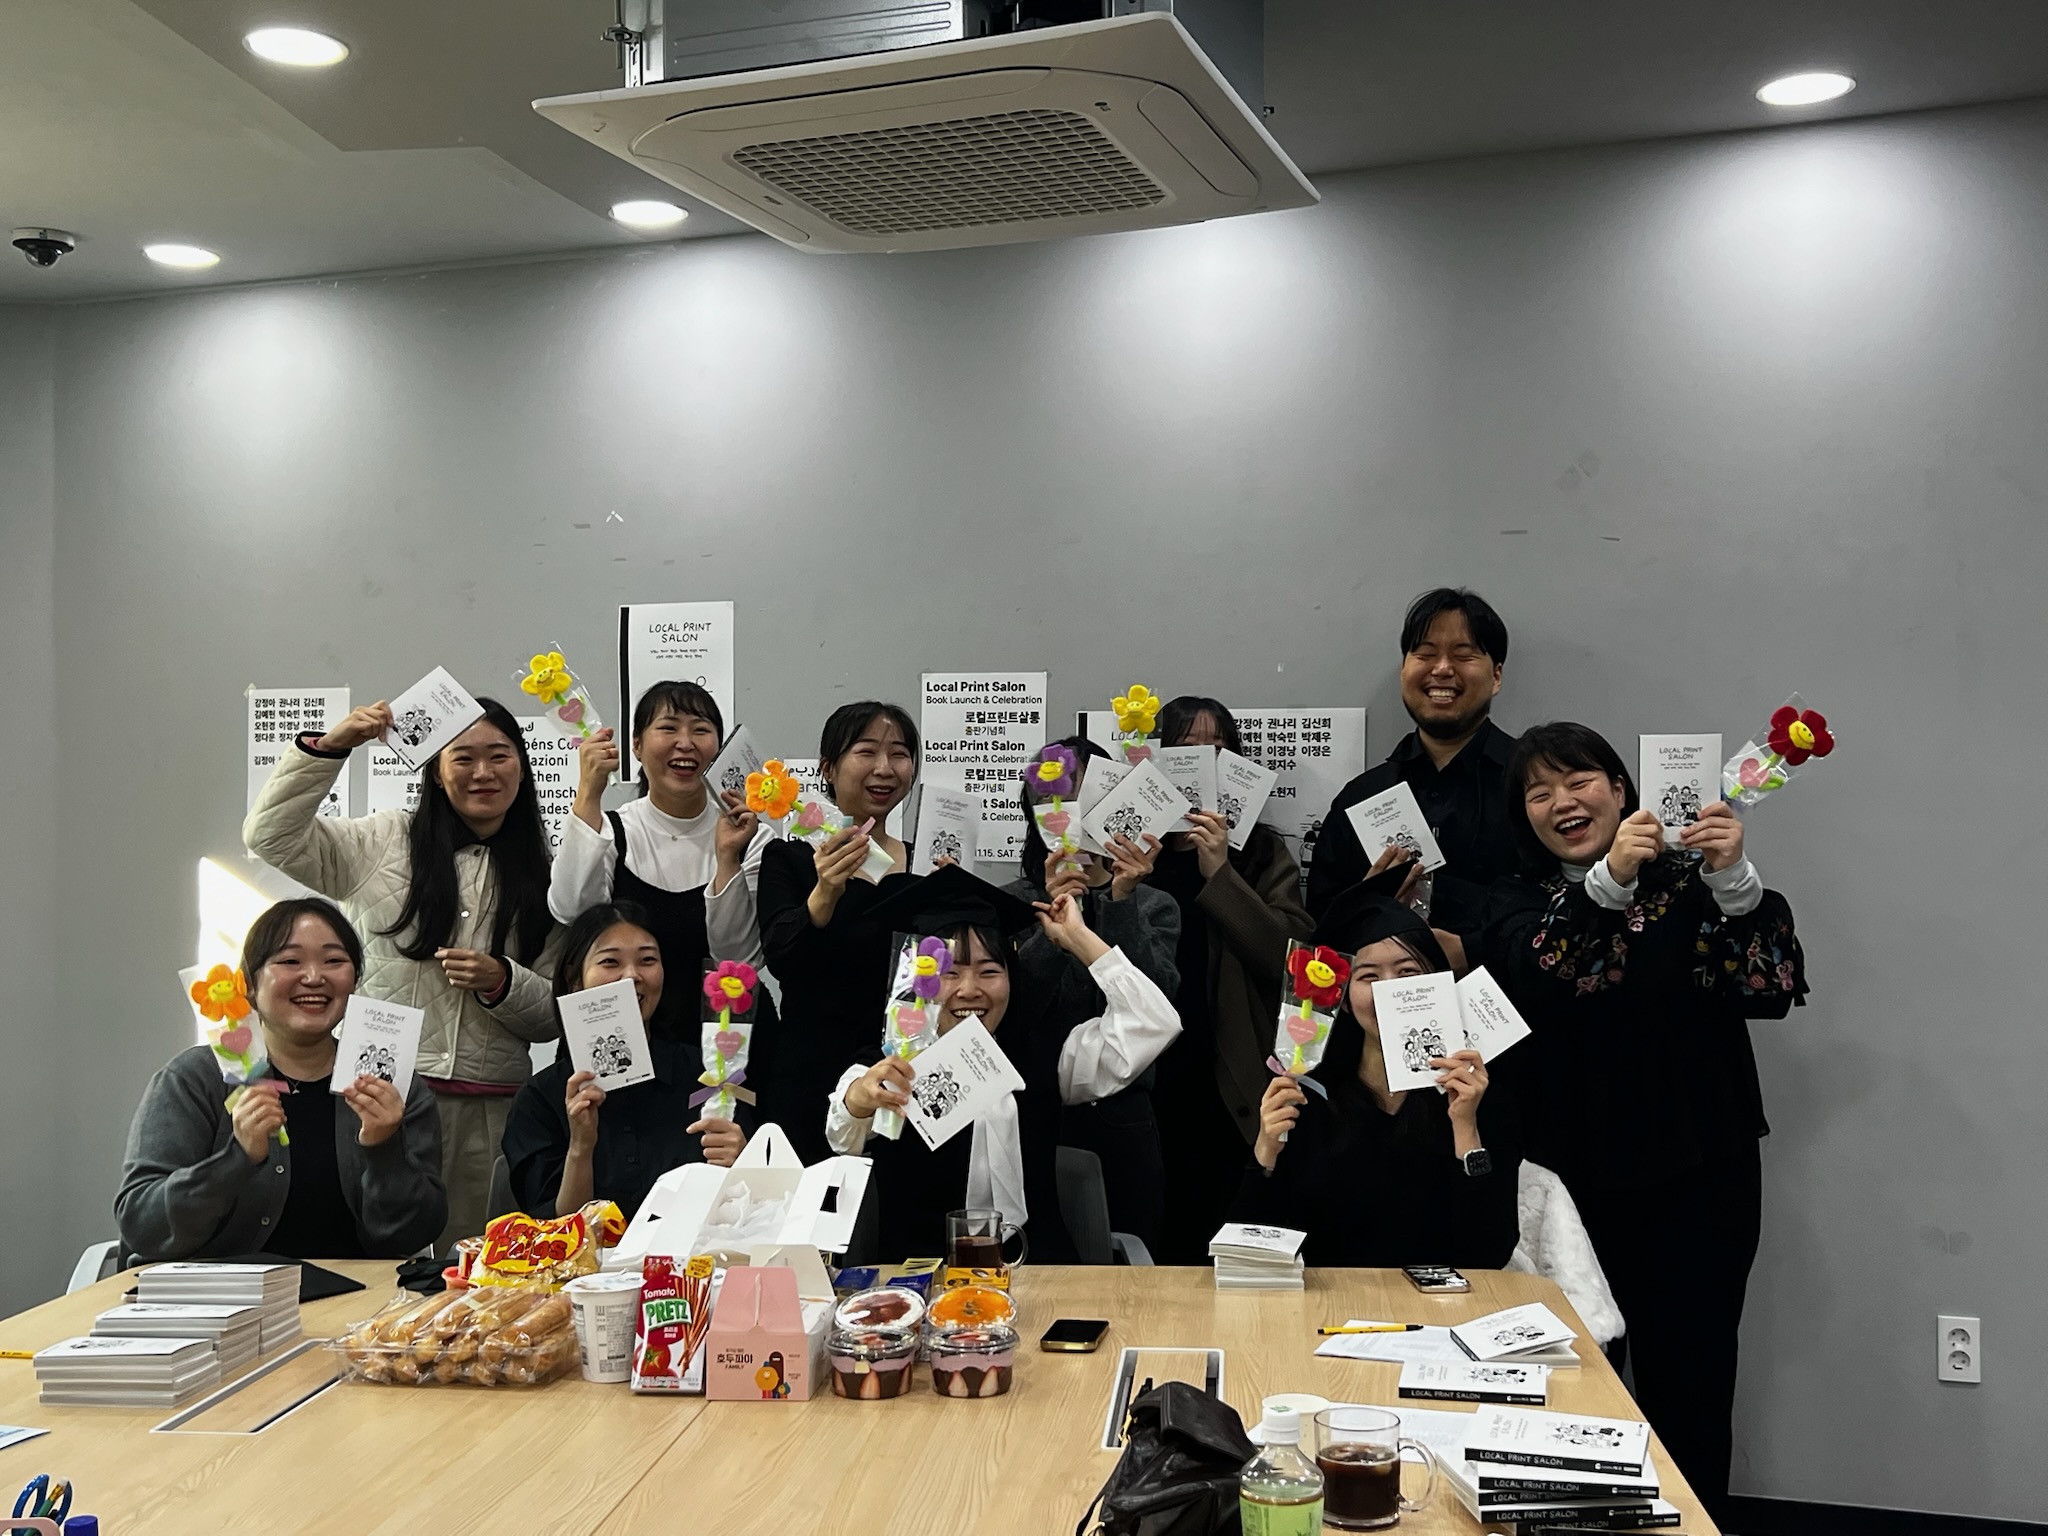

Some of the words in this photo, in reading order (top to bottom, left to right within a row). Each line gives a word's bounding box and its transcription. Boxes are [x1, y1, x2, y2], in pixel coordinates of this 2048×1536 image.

[648, 624, 680, 633] LOCAL
[683, 622, 712, 632] PRINT
[661, 633, 698, 643] SALON
[927, 682, 957, 691] Local
[961, 681, 989, 691] Print
[992, 682, 1026, 691] Salon
[926, 696, 948, 704] Book
[950, 696, 981, 704] Launch
[984, 696, 990, 704] &
[992, 696, 1042, 704] Celebration
[965, 711, 1040, 724] 로컬프린트살롱
[1267, 718, 1296, 729] 권나리
[965, 726, 1005, 735] 출판기념회
[1112, 732, 1138, 740] LOCA
[1239, 732, 1262, 742] 예현
[1267, 732, 1296, 742] 박숙민
[926, 740, 957, 750] Local
[960, 740, 989, 750] Print
[992, 740, 1025, 750] Salon
[1243, 746, 1262, 756] 현경
[1302, 746, 1331, 756] 이정은
[373, 756, 399, 765] Local
[926, 754, 947, 762] Book
[950, 754, 980, 762] Launch
[1267, 760, 1296, 770] 정지수
[965, 783, 1005, 793] 출판기념회
[990, 812, 1024, 821] Celebra
[1392, 990, 1414, 998] LOCAL
[1416, 986, 1435, 994] PRINT
[1402, 995, 1428, 1003] SALON
[365, 1008, 385, 1018] LOCAL
[387, 1013, 406, 1022] PRINT
[372, 1015, 396, 1025] SALON
[643, 1287, 675, 1299] Tomato
[646, 1300, 688, 1326] PRETZ
[1480, 1452, 1505, 1461] LOCAL
[1508, 1454, 1530, 1463] PRINT
[1534, 1456, 1563, 1466] SALON
[1494, 1480, 1520, 1488] LOCAL
[1523, 1481, 1546, 1490] PRINT
[1550, 1483, 1580, 1491] SALON
[1493, 1494, 1518, 1502] LOCAL
[1496, 1511, 1521, 1520] LOCAL
[1524, 1511, 1547, 1519] PRINT
[1550, 1510, 1578, 1518] SALON
